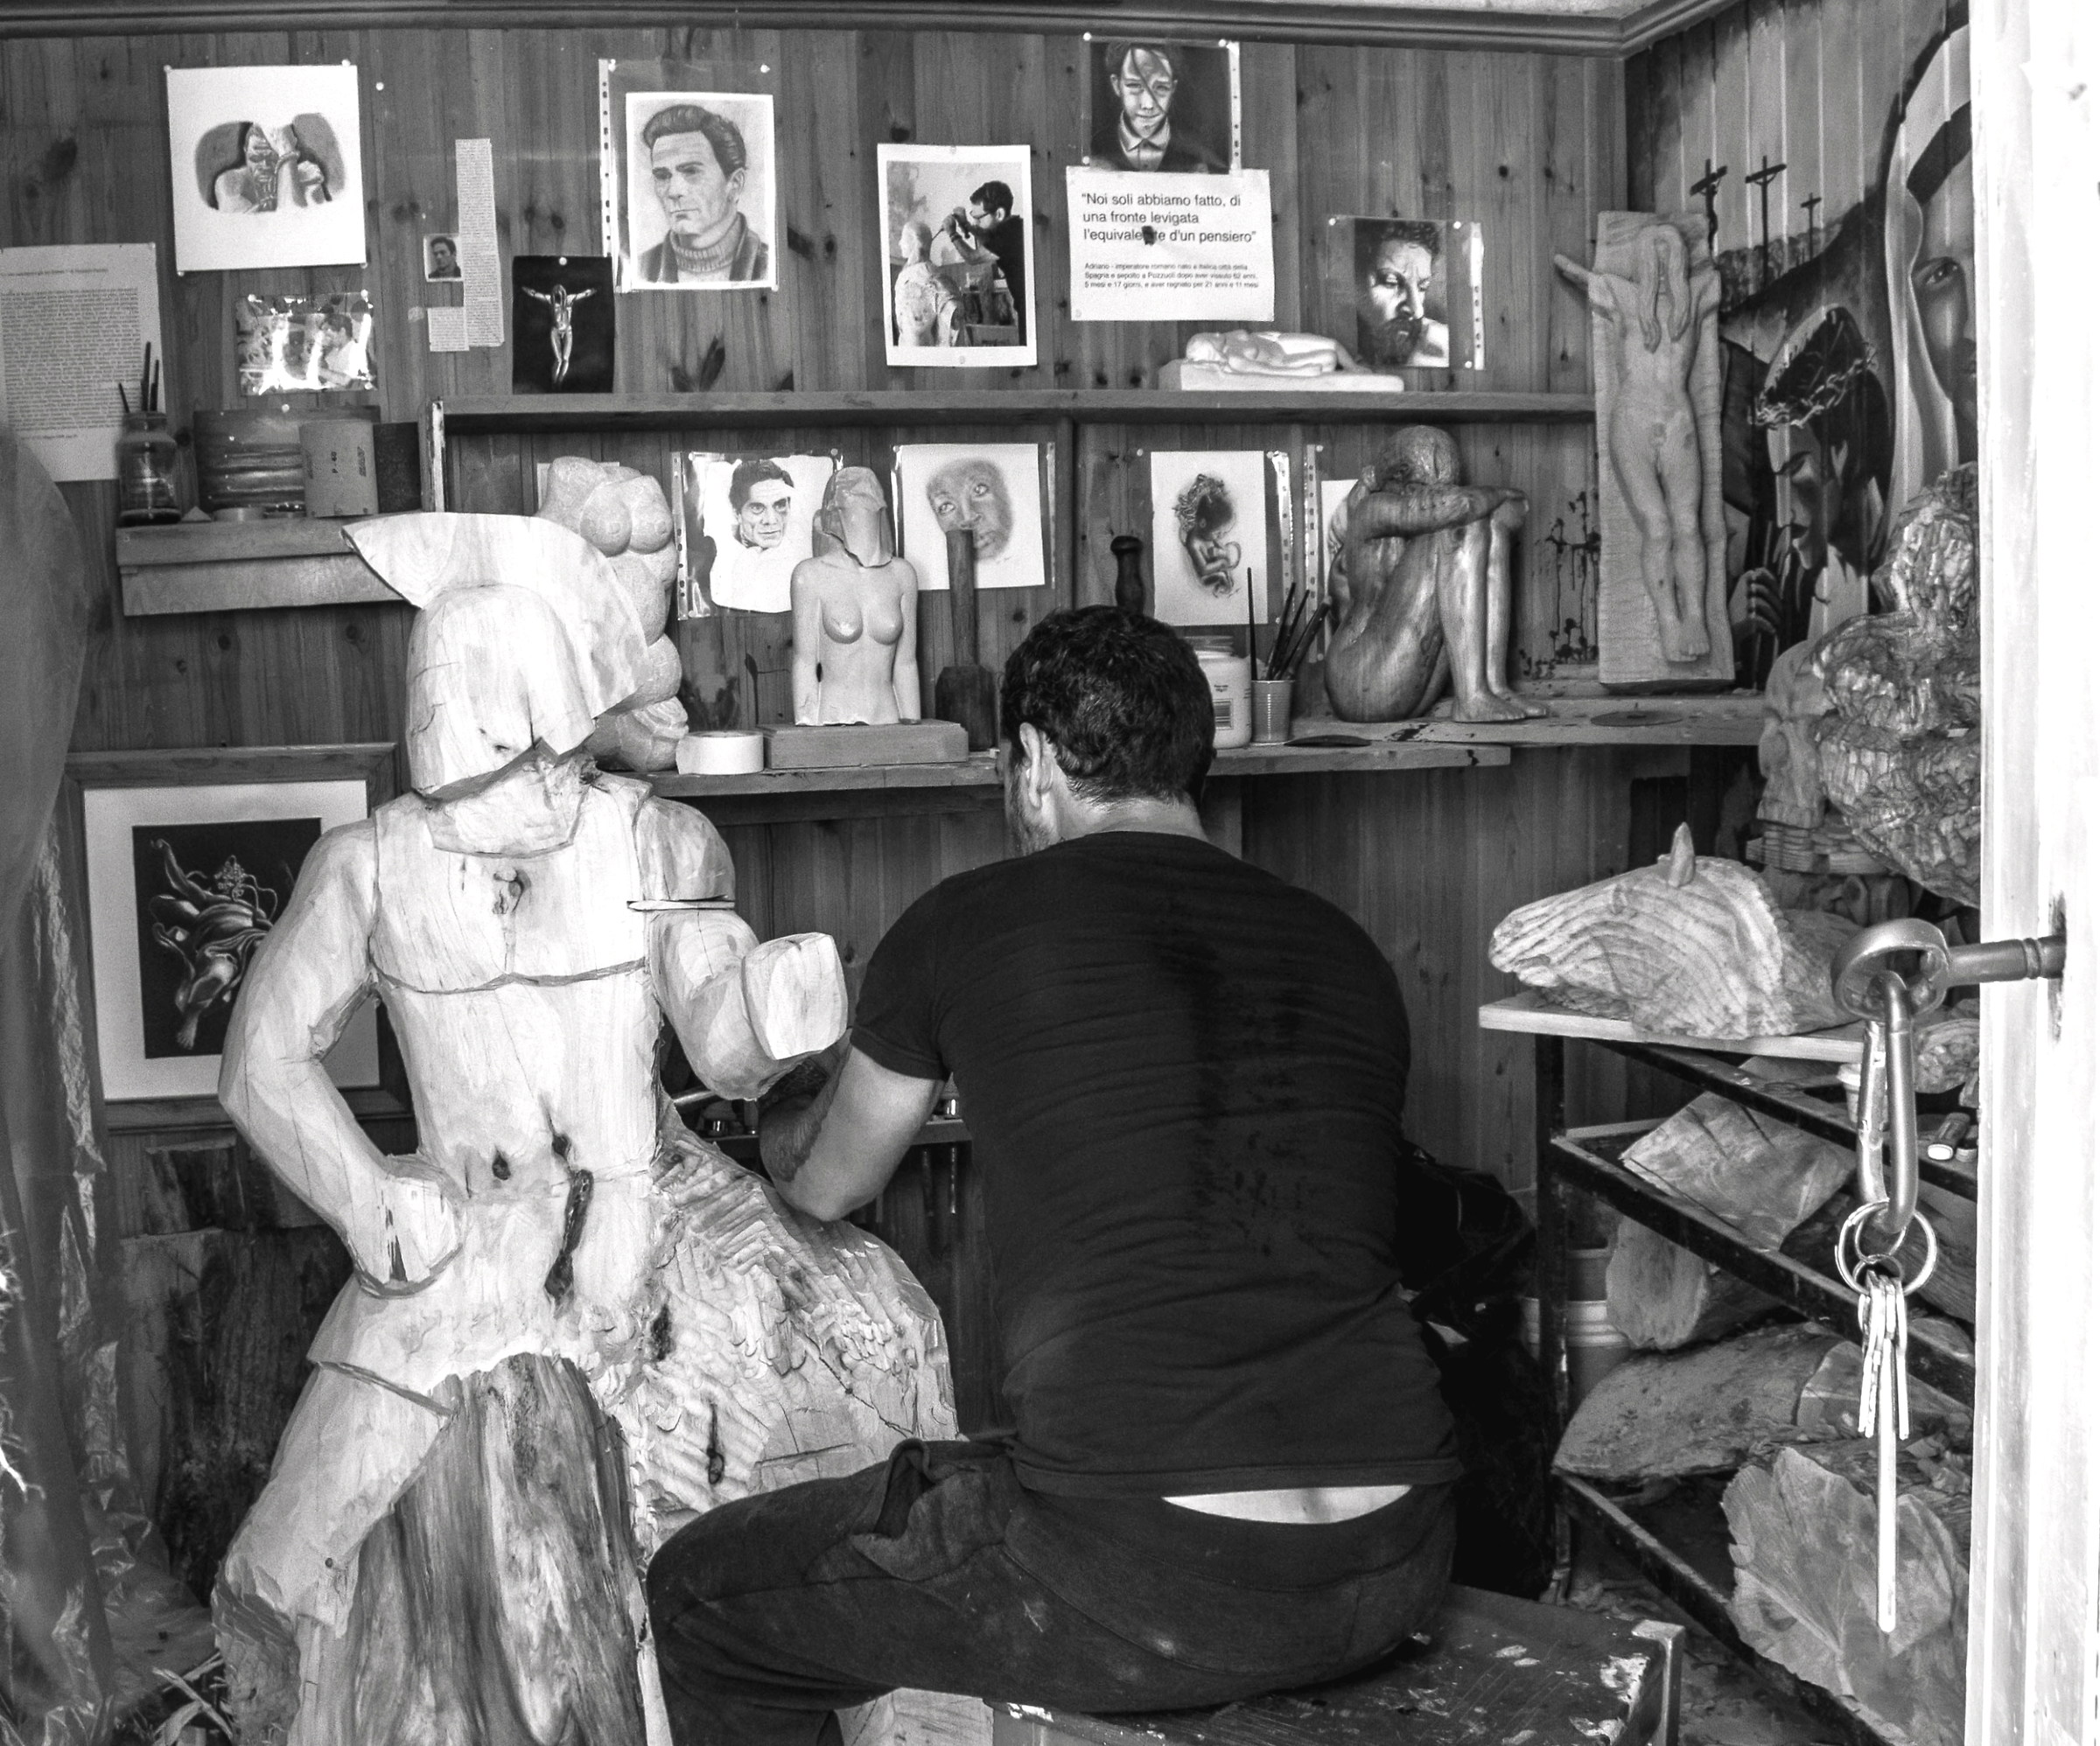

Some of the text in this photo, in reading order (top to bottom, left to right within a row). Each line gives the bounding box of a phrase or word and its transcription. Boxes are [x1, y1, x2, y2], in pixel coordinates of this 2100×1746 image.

[1082, 192, 1241, 207] "Noi soli abbiamo fatto, di
[1083, 211, 1199, 227] una fronte levigata
[1084, 228, 1256, 244] l'equivalete d'un pensiero"
[1085, 271, 1110, 280] Spagna
